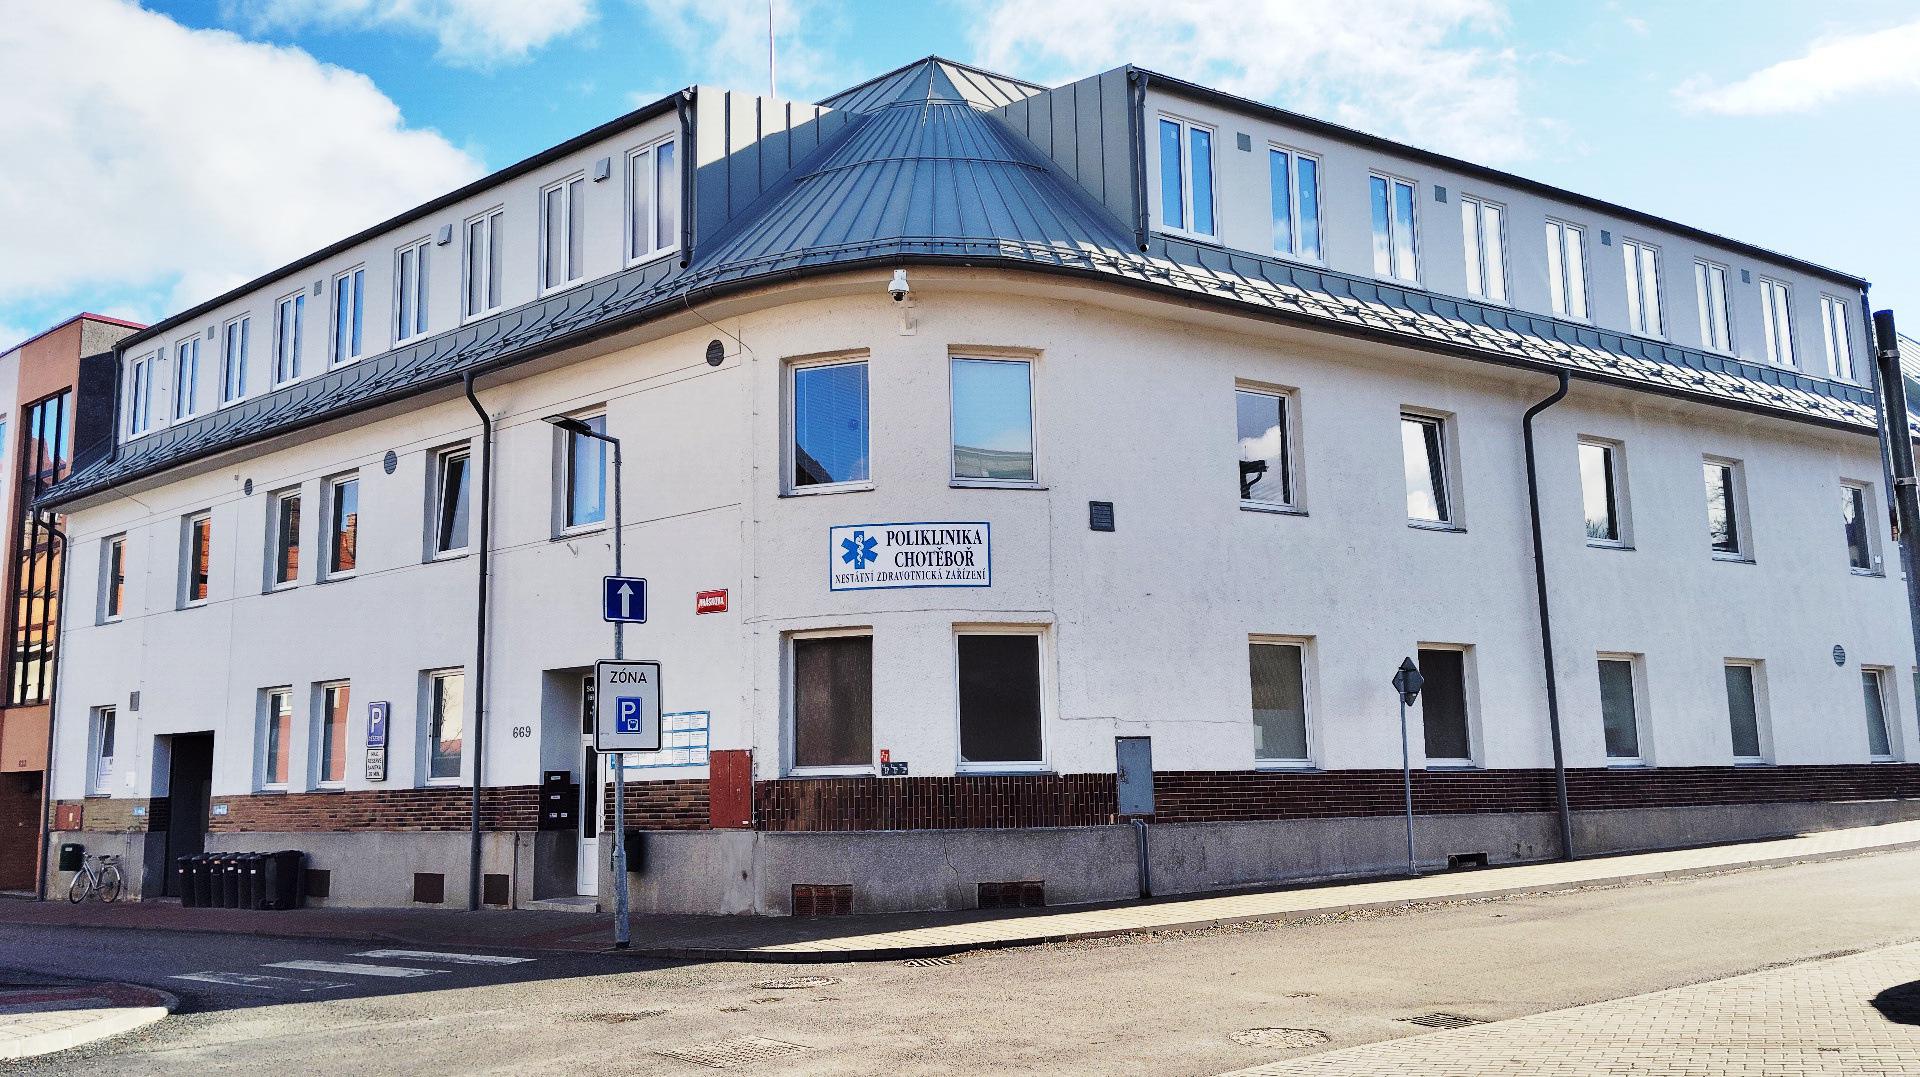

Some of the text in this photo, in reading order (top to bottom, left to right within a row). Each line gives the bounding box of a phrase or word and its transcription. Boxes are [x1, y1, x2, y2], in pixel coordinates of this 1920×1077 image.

[886, 529, 983, 546] POLIKLINIKA
[894, 546, 975, 567] CHOTĚBOŘ
[835, 570, 874, 583] NESTÁTNÍ
[876, 568, 943, 581] ZDRAVOTNICKÁ
[609, 667, 648, 684] ZÓNA
[370, 707, 382, 733] P
[621, 701, 637, 722] P
[512, 726, 532, 738] 669
